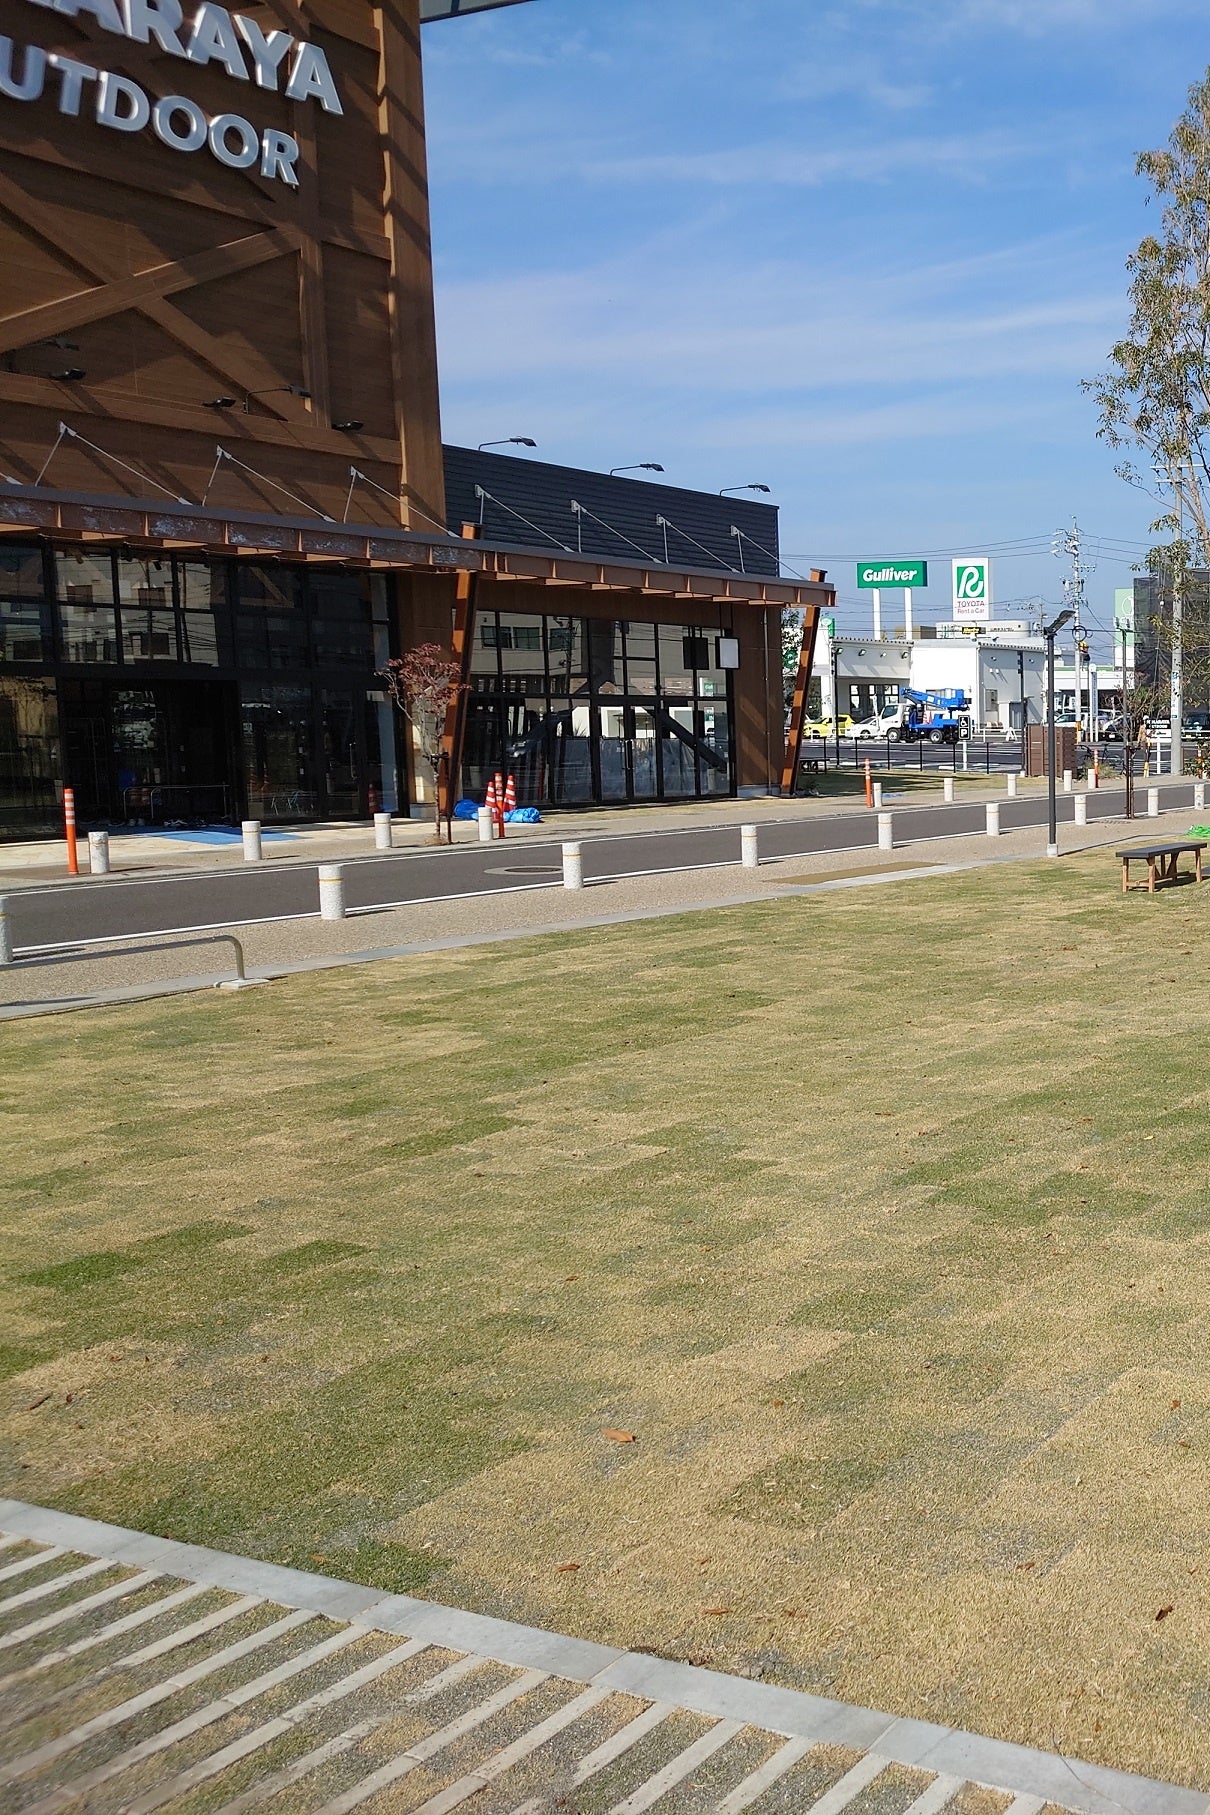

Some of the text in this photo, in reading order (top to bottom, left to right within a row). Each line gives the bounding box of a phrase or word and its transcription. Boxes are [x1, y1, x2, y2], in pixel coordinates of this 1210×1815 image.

[863, 567, 917, 583] Gulliver
[957, 600, 985, 608] TOYOTA
[960, 728, 968, 737] P
